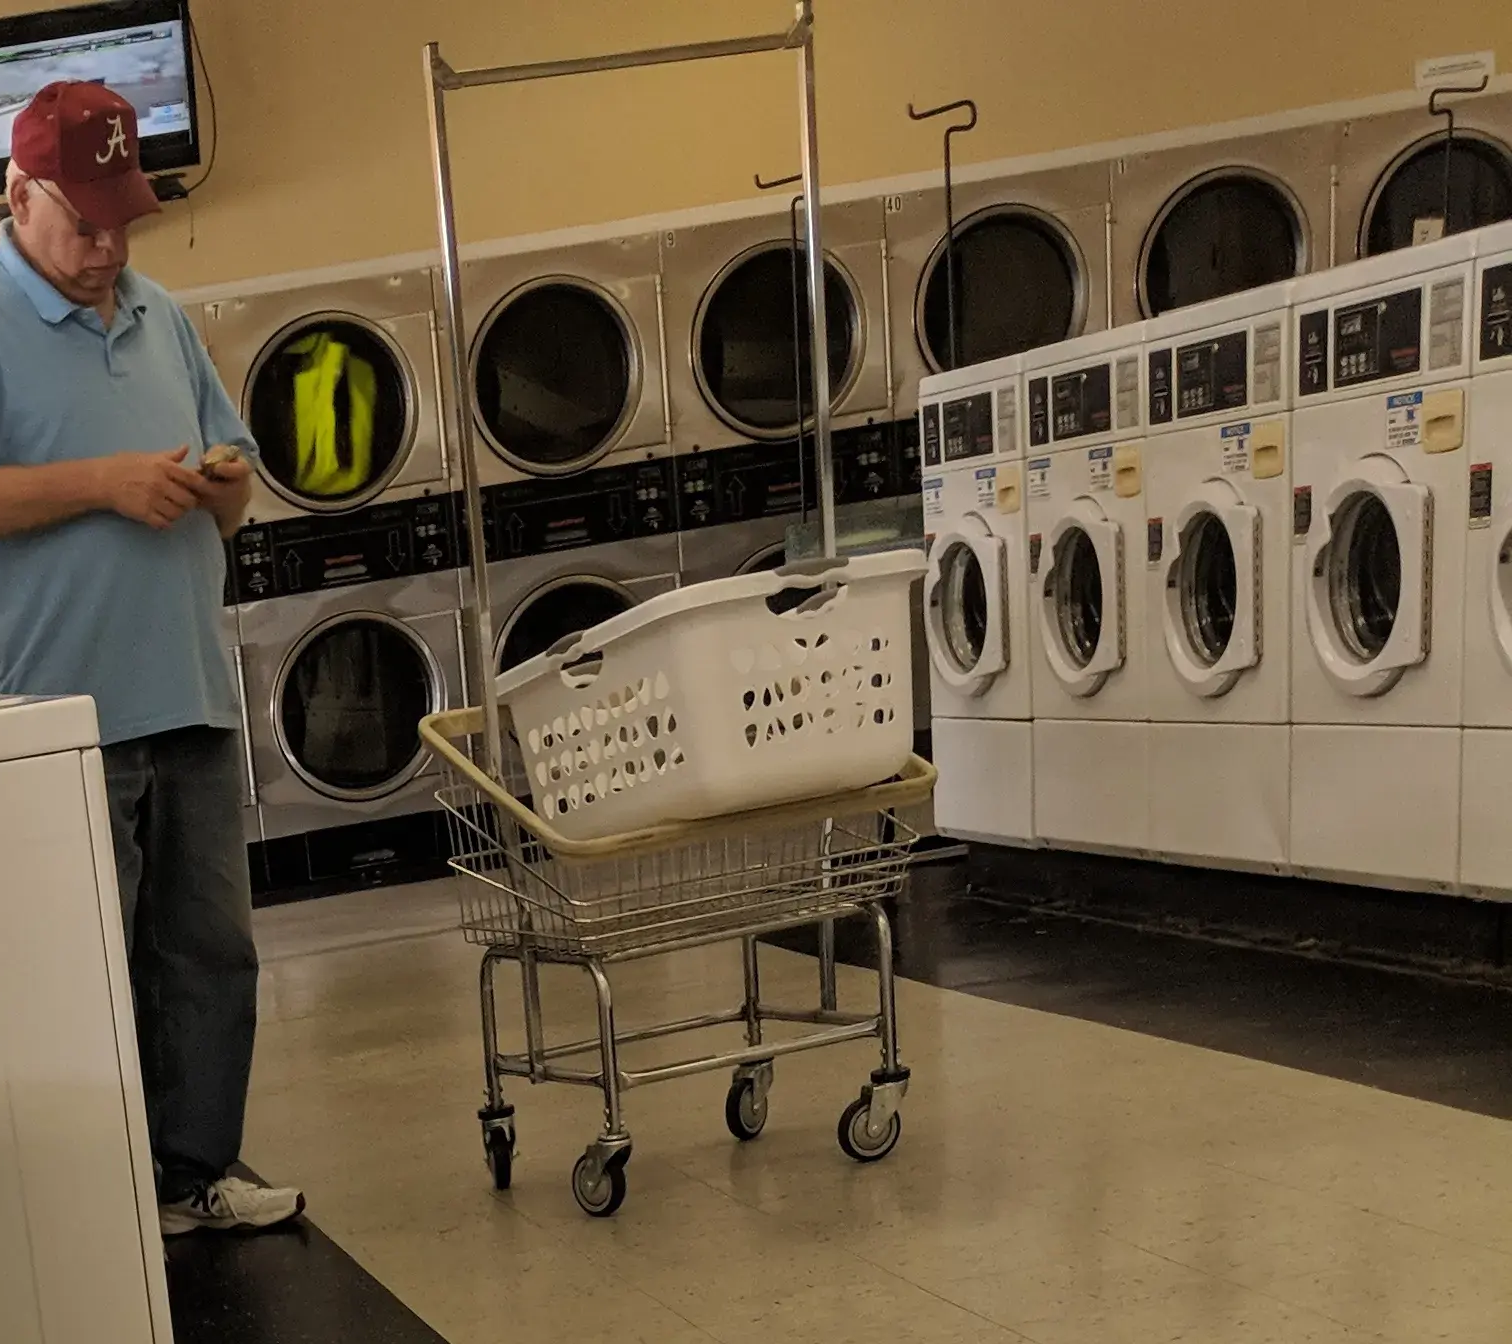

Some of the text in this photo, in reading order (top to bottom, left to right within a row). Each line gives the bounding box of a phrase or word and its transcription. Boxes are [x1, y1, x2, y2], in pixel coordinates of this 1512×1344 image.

[96, 115, 128, 164] A
[667, 231, 674, 246] 9
[212, 304, 219, 320] 7
